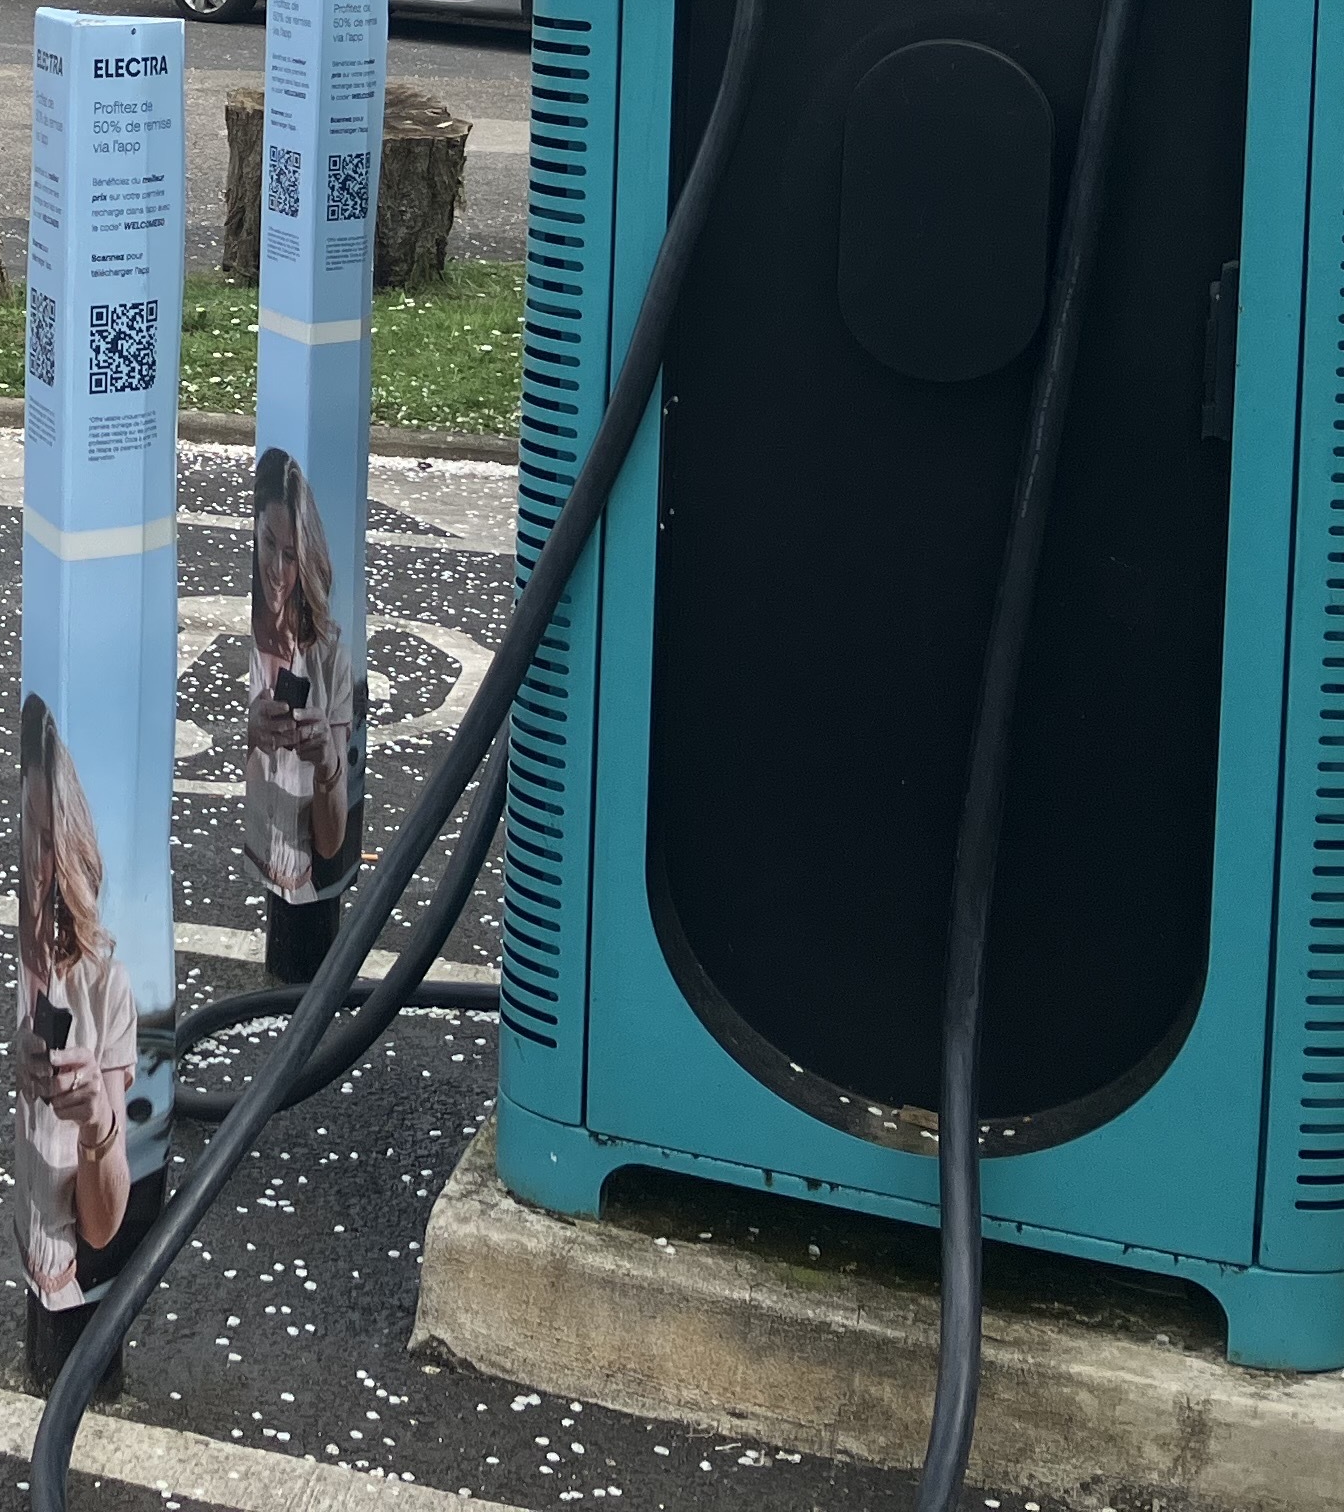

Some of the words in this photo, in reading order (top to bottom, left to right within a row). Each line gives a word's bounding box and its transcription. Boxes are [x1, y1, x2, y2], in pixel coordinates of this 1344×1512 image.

[93, 54, 169, 79] ELECTRA
[93, 100, 138, 115] Profitez
[140, 100, 153, 113] de
[93, 120, 122, 134] 50%
[125, 119, 141, 133] de
[143, 118, 172, 132] remise
[92, 141, 110, 154] via
[113, 139, 141, 156] l'app
